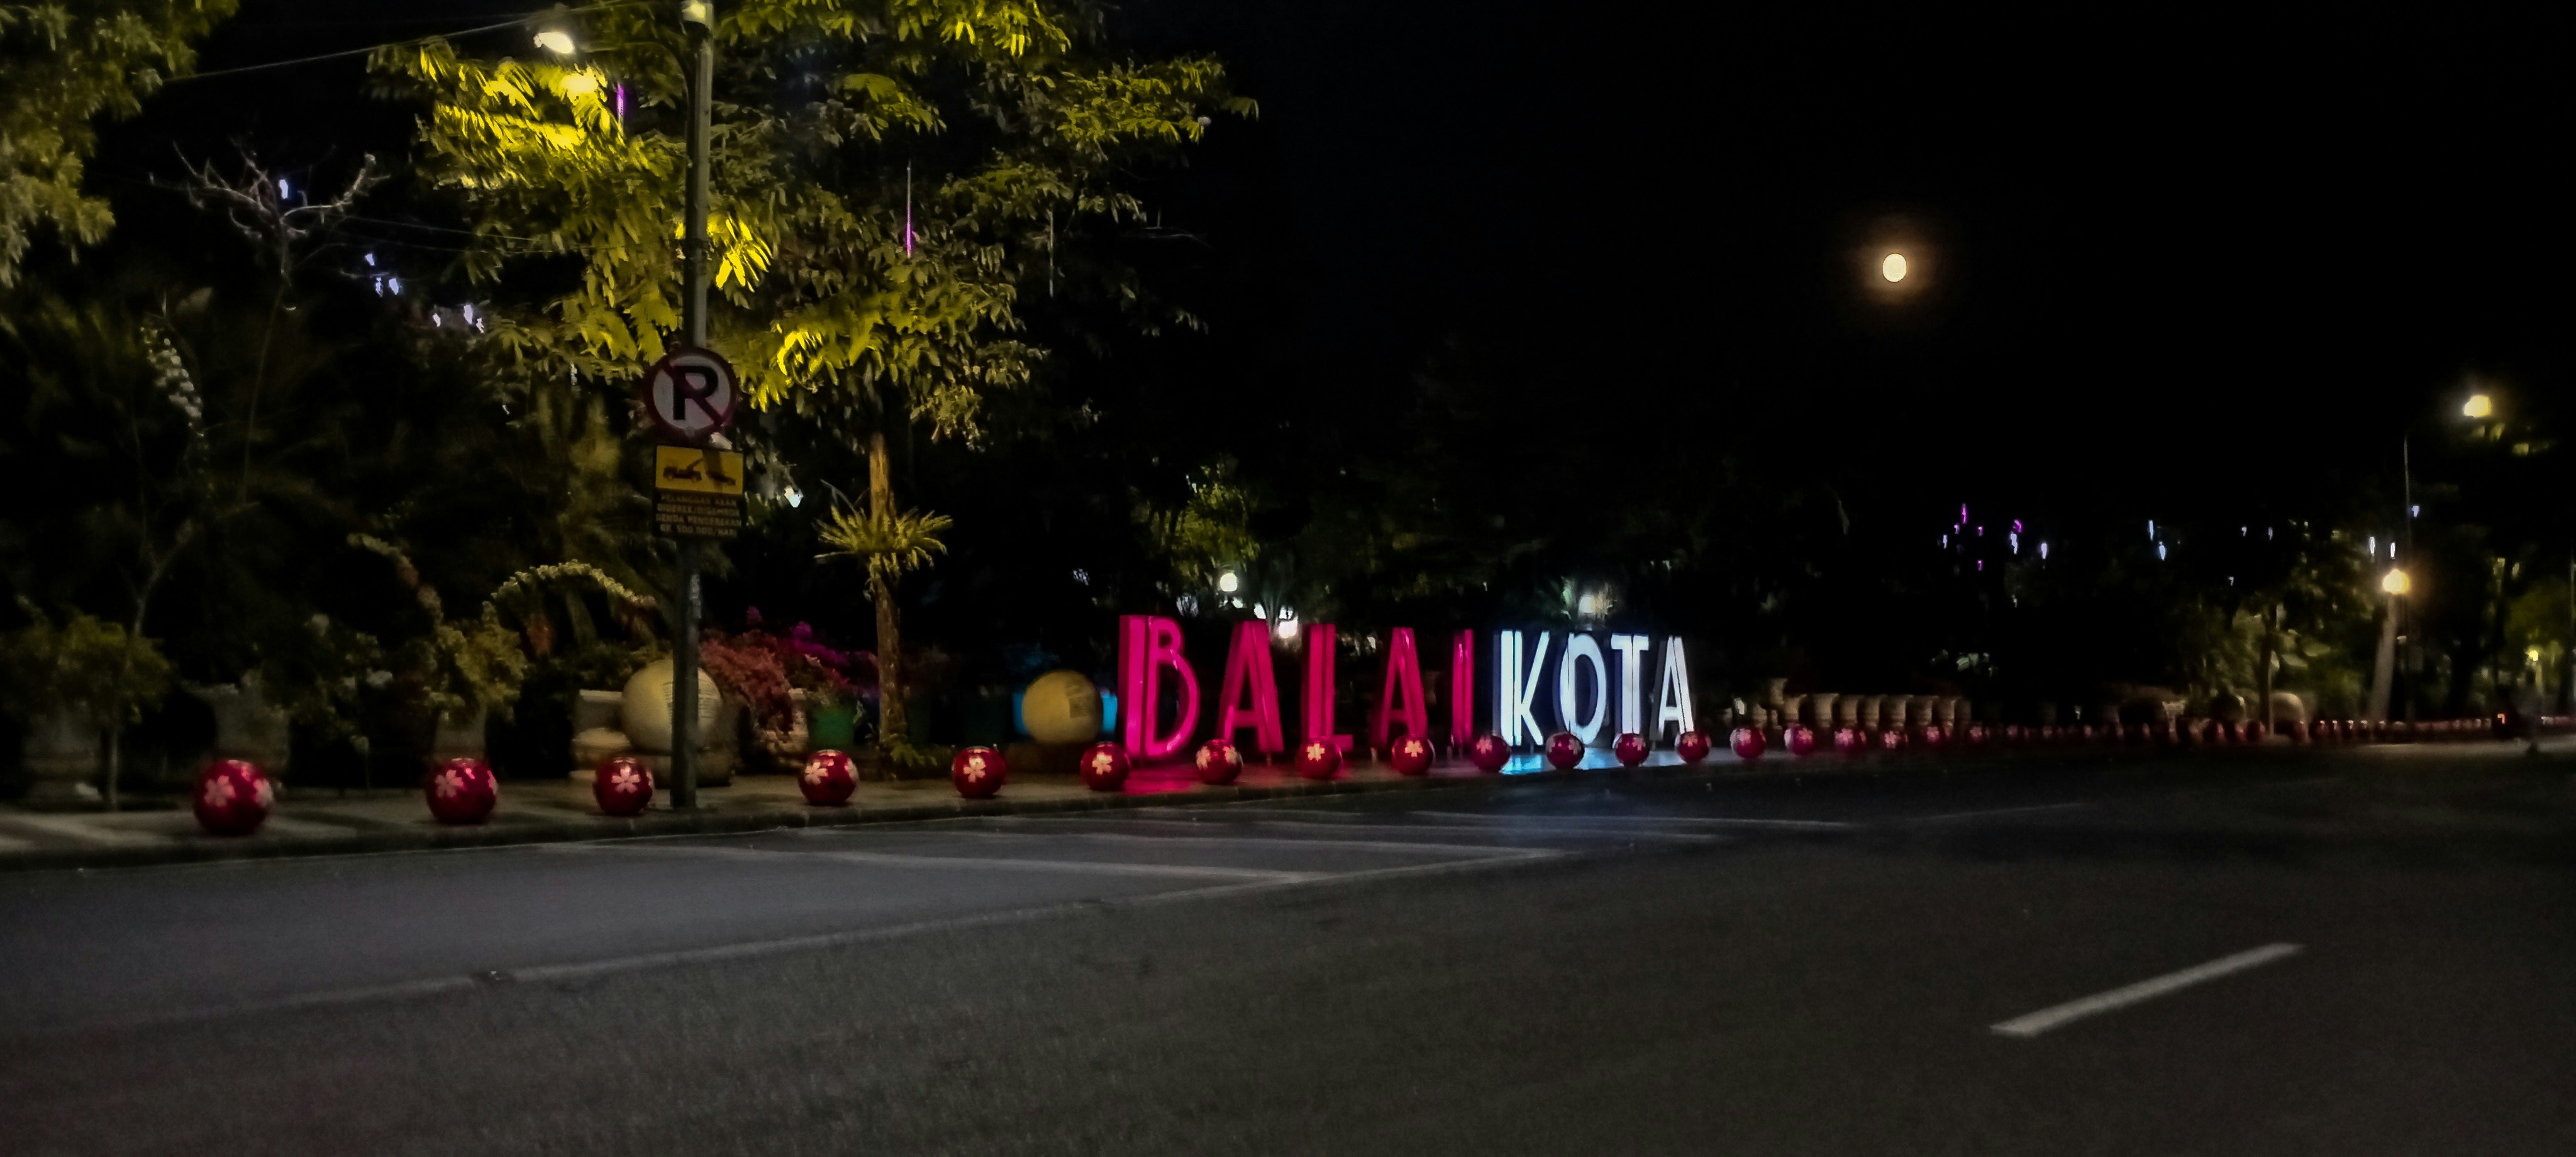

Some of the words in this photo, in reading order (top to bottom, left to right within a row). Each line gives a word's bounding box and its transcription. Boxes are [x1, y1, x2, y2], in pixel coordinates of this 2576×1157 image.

[673, 366, 718, 420] P
[1118, 614, 1474, 756] BALAI
[1494, 629, 1694, 747] KOTA
